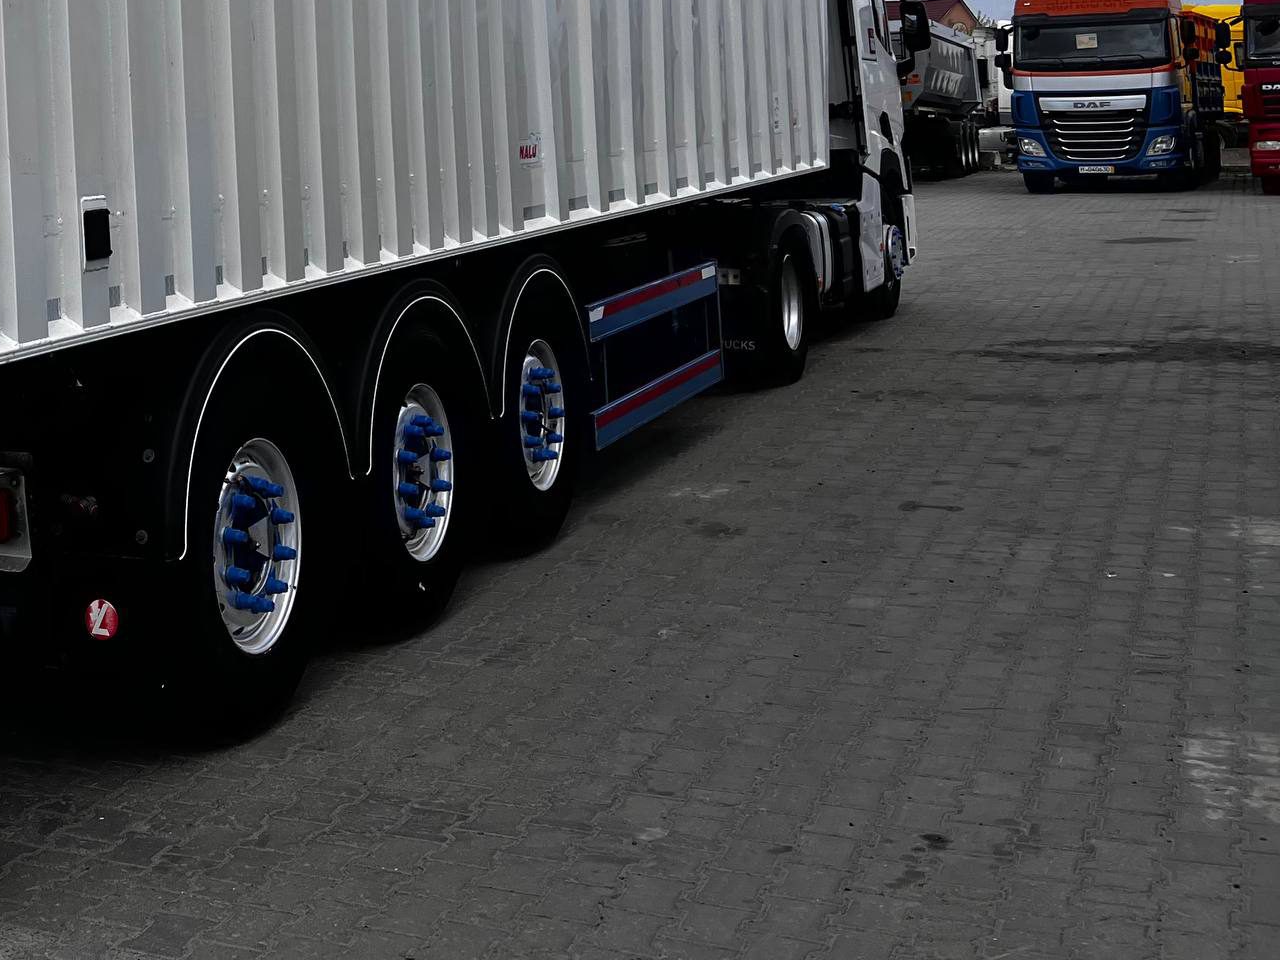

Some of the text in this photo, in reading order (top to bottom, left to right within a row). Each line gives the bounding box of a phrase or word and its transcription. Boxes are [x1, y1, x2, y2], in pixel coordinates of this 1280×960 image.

[1073, 101, 1111, 109] DAF
[520, 144, 537, 159] NALU
[724, 339, 756, 350] UCKS
